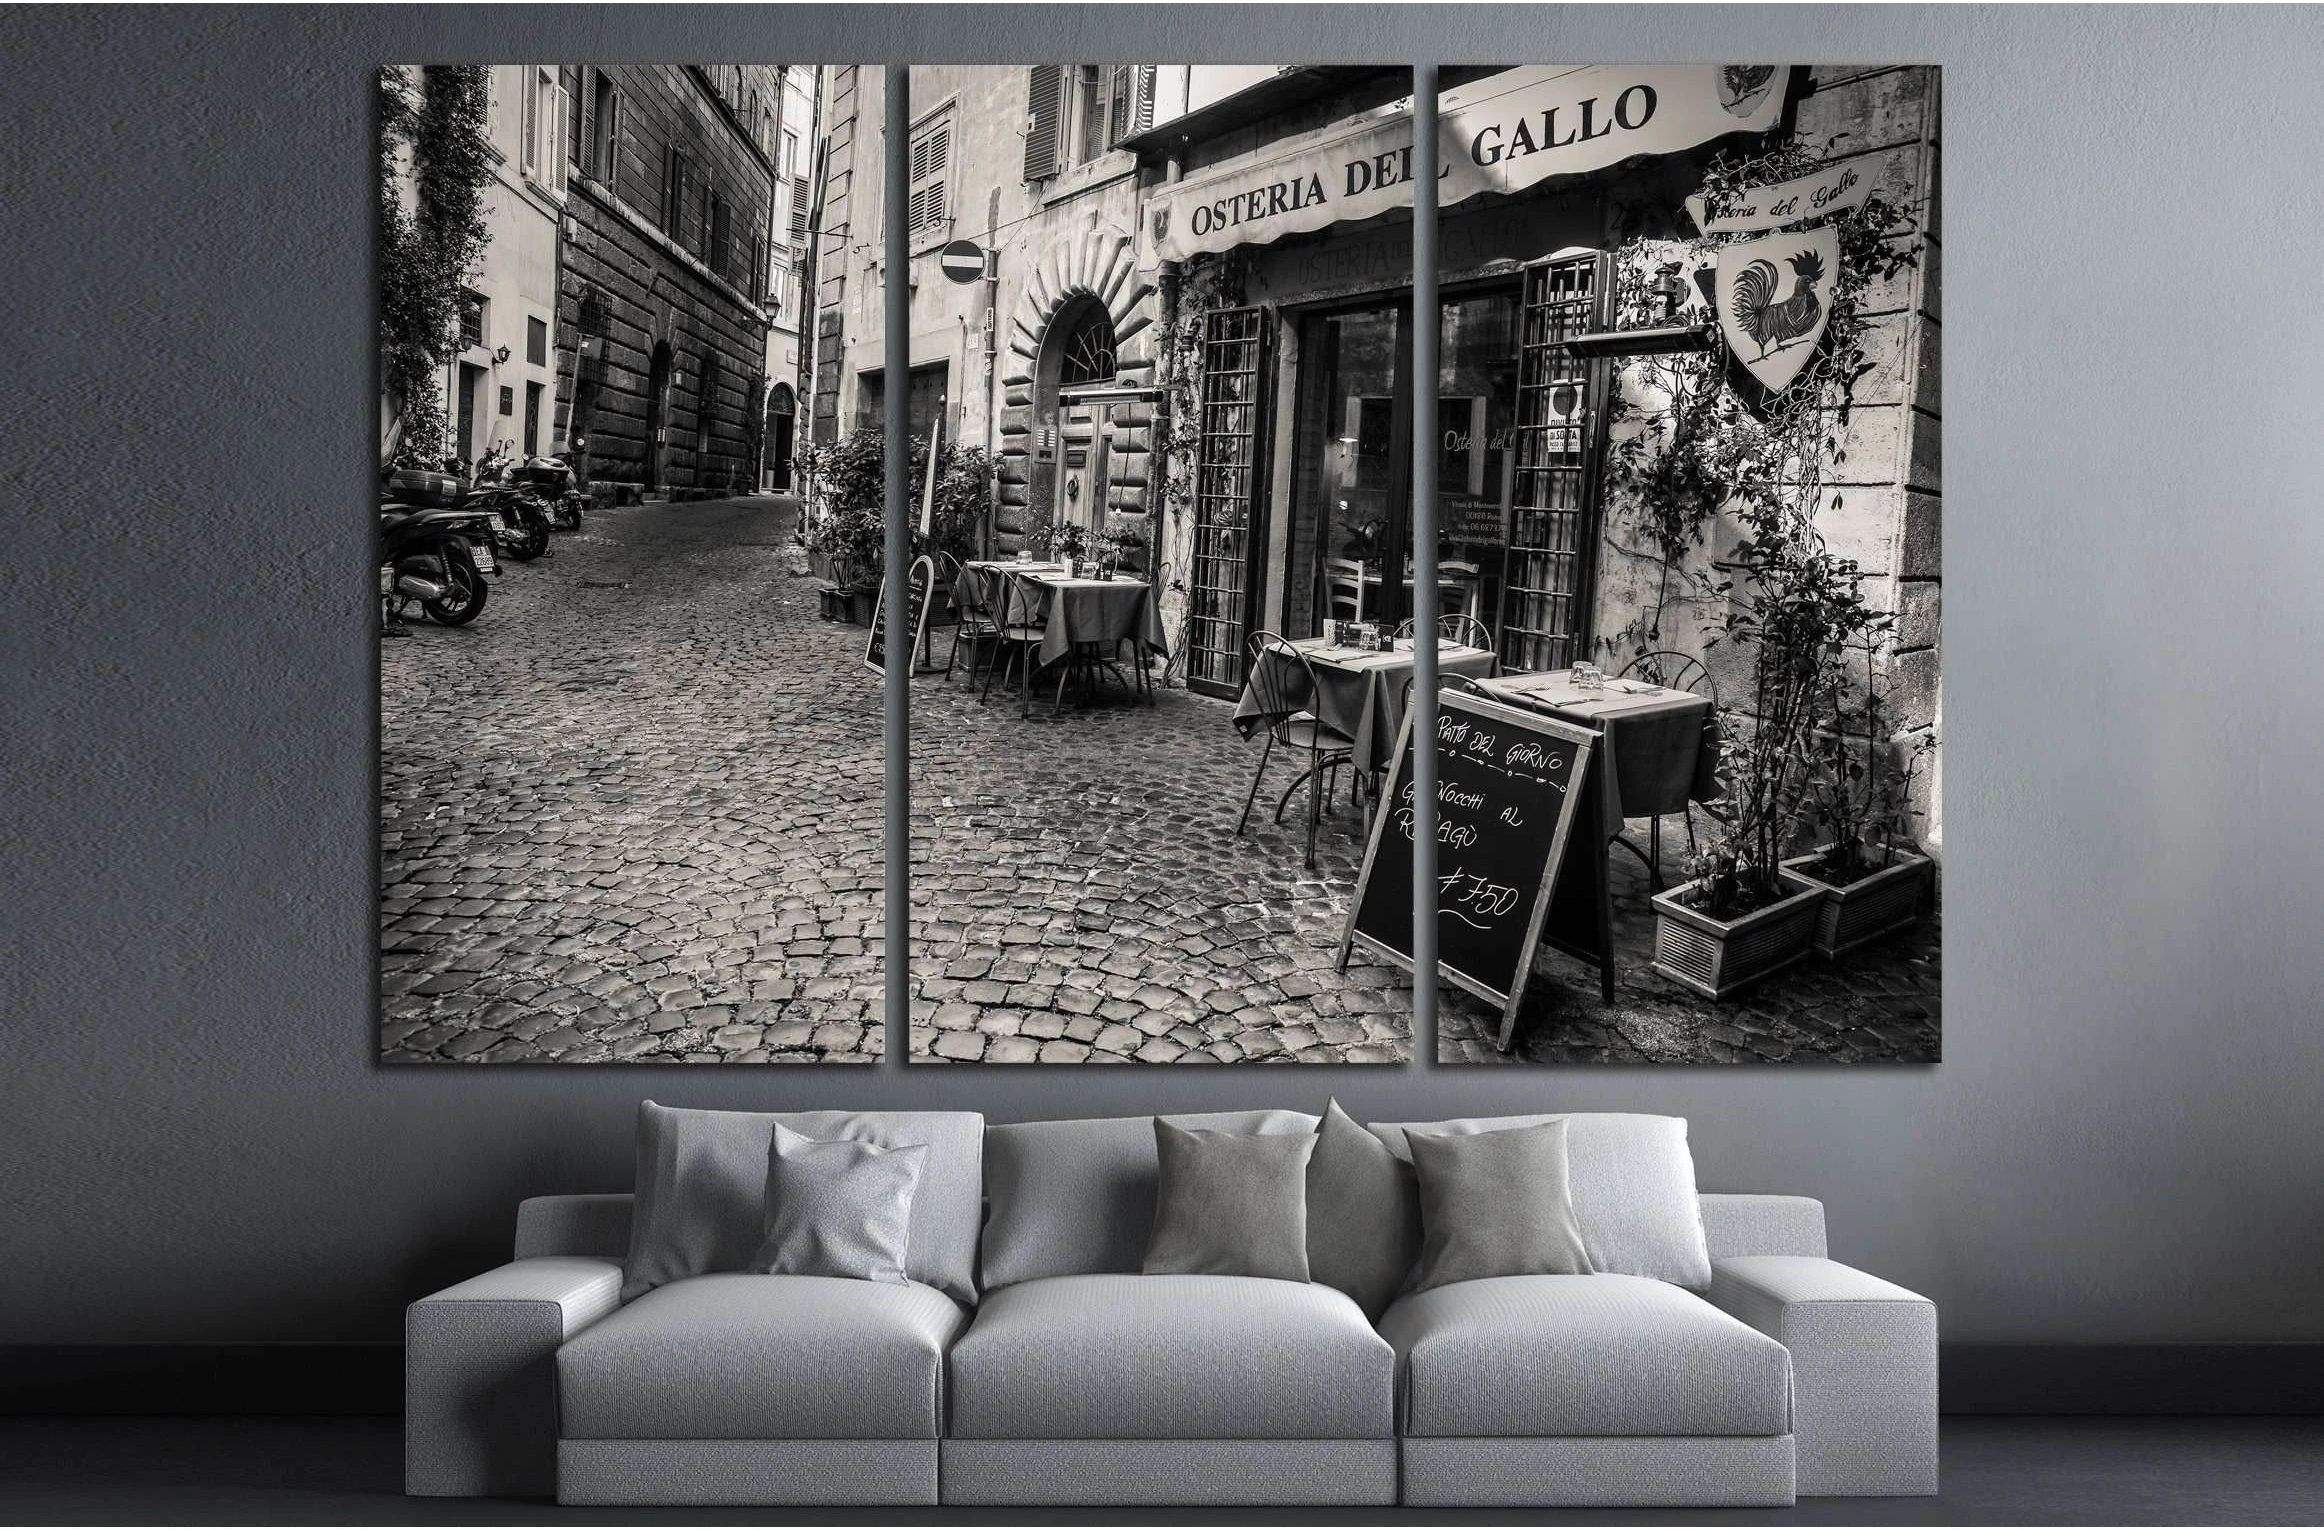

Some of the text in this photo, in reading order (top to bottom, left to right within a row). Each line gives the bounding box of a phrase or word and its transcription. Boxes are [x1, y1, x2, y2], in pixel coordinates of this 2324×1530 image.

[1191, 172, 1328, 236] OSTERIA
[1471, 84, 1658, 167] GALLO
[1769, 196, 1799, 217] del
[1810, 168, 1860, 209] Gallo
[1469, 731, 1496, 757] DEL
[1500, 806, 1523, 827] AL
